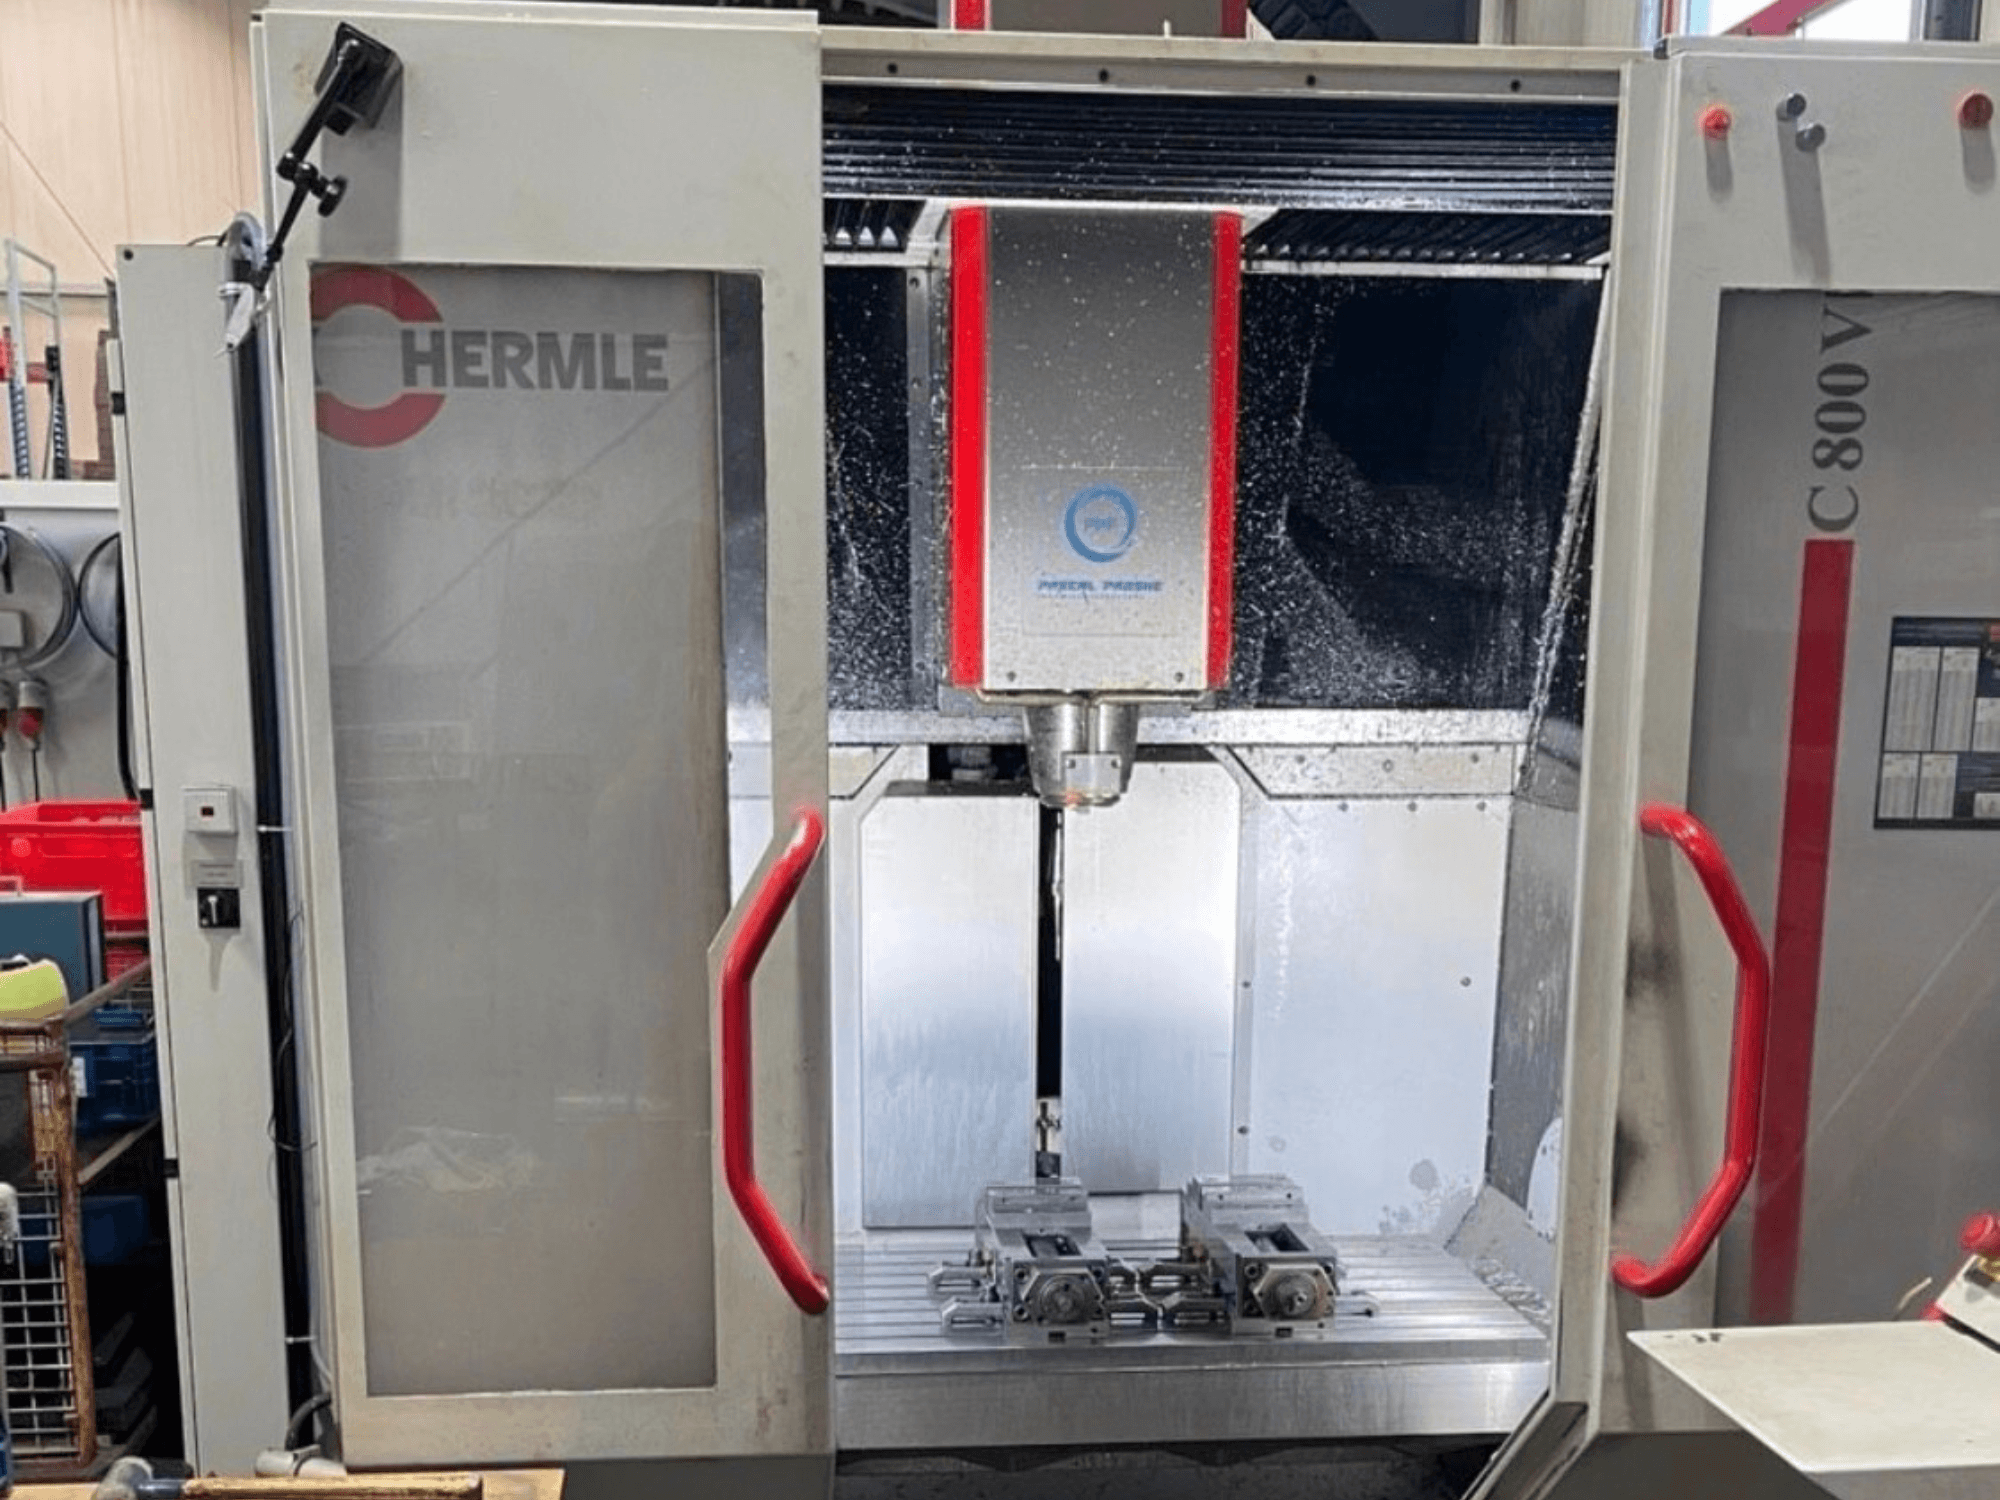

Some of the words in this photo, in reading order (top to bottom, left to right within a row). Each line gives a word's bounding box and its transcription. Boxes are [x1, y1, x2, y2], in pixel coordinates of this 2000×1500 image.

[1819, 302, 1873, 354] V
[401, 329, 670, 391] HERMLE
[1811, 362, 1870, 471] 800
[1807, 484, 1860, 533] C
